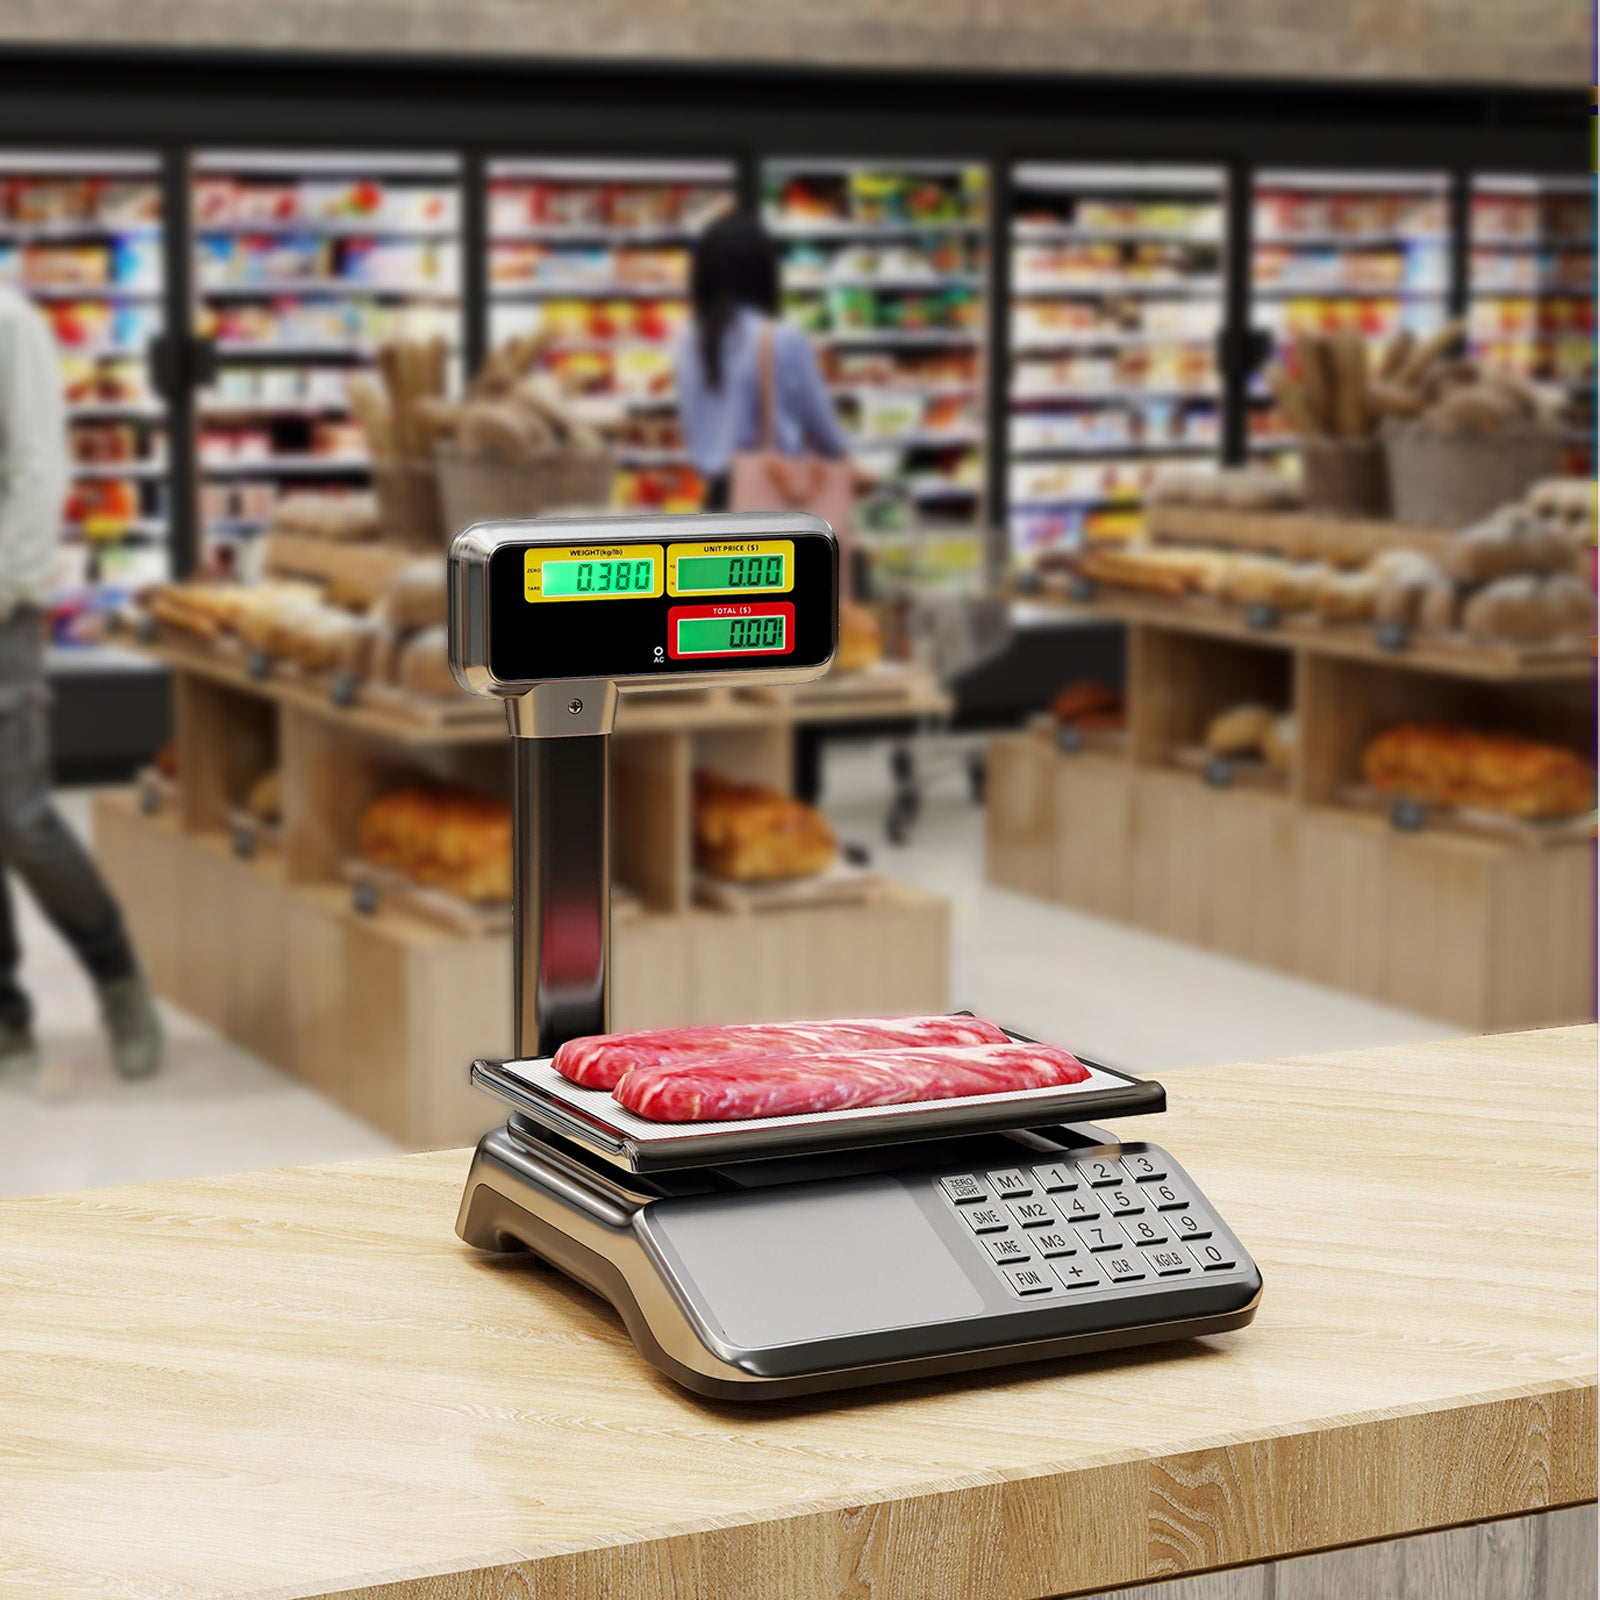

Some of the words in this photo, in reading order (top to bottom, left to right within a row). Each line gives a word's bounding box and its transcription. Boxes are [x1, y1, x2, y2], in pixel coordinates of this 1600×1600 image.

[723, 544, 744, 552] PRICE
[747, 544, 759, 552] ($)
[576, 561, 651, 592] 0.380
[728, 557, 781, 587] 0.00
[712, 606, 737, 615] TOTAL
[739, 606, 752, 614] ($)
[729, 617, 778, 648] 0.00
[653, 656, 665, 664] AC
[1093, 1163, 1111, 1178] 2
[1137, 1158, 1154, 1172] 3
[949, 1177, 974, 1188] ZERO
[997, 1175, 1025, 1190] M1
[1050, 1169, 1064, 1184] 1
[954, 1187, 981, 1198] LIGHT
[1114, 1191, 1131, 1207] 5
[1158, 1185, 1176, 1201] 6
[1018, 1203, 1048, 1219] M2
[1072, 1198, 1086, 1213] 4
[972, 1209, 1000, 1225] SAVE
[1180, 1215, 1198, 1231] 9
[1090, 1228, 1105, 1244] 7
[1137, 1222, 1155, 1238] 8
[993, 1240, 1022, 1255] TARE
[1039, 1234, 1066, 1249] M3
[1205, 1245, 1222, 1262] 0
[1111, 1259, 1134, 1273] CLR
[1015, 1271, 1042, 1286] FUN
